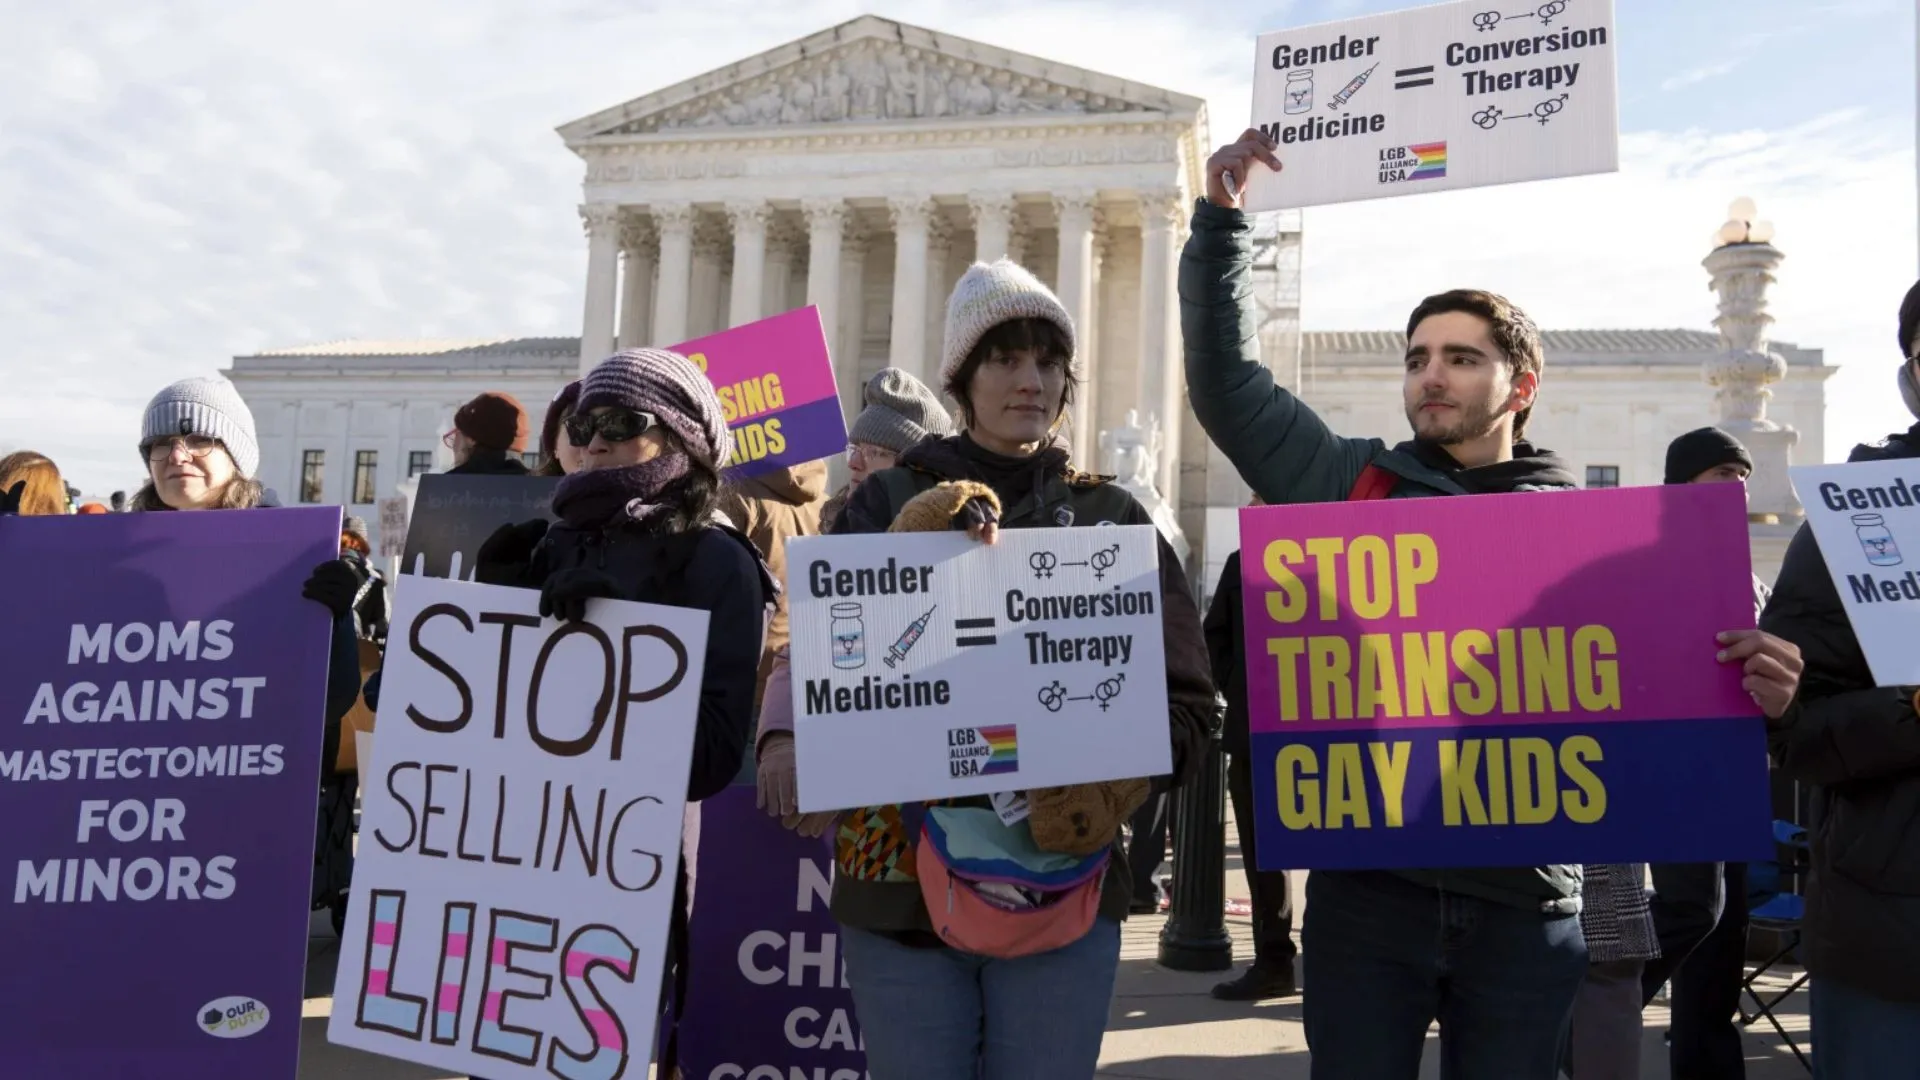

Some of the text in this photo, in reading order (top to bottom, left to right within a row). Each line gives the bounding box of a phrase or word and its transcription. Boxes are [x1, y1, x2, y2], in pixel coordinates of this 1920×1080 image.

[1272, 35, 1380, 70] Gender
[1446, 26, 1607, 66] Conversion
[1462, 62, 1580, 96] Therapy
[1260, 113, 1385, 145] Medicine
[1379, 147, 1406, 161] LGB
[1380, 158, 1418, 170] ALLIANCE
[1379, 169, 1406, 183] USA
[810, 558, 934, 598] Gender
[1262, 532, 1439, 623] STOP
[1847, 571, 1920, 604] Med
[1006, 585, 1154, 622] Conversion
[68, 619, 234, 664] MOMS
[1024, 631, 1133, 666] Therapy
[405, 603, 689, 760] STOP
[1267, 624, 1621, 721] TRANSING
[23, 676, 266, 725] AGAINST
[805, 675, 950, 715] Medicine
[948, 728, 976, 746] LGB
[950, 745, 991, 759] ALLIANCE
[0, 744, 284, 781] MASTECTOMIES
[950, 759, 979, 777] USA
[1275, 735, 1607, 830] GAY KIDS
[76, 798, 187, 843] FOR
[374, 761, 664, 891] SELLING
[14, 855, 237, 904] MINORS
[355, 888, 639, 1080] LIES
[226, 1001, 256, 1019] OUR
[228, 1008, 265, 1030] DUTY
